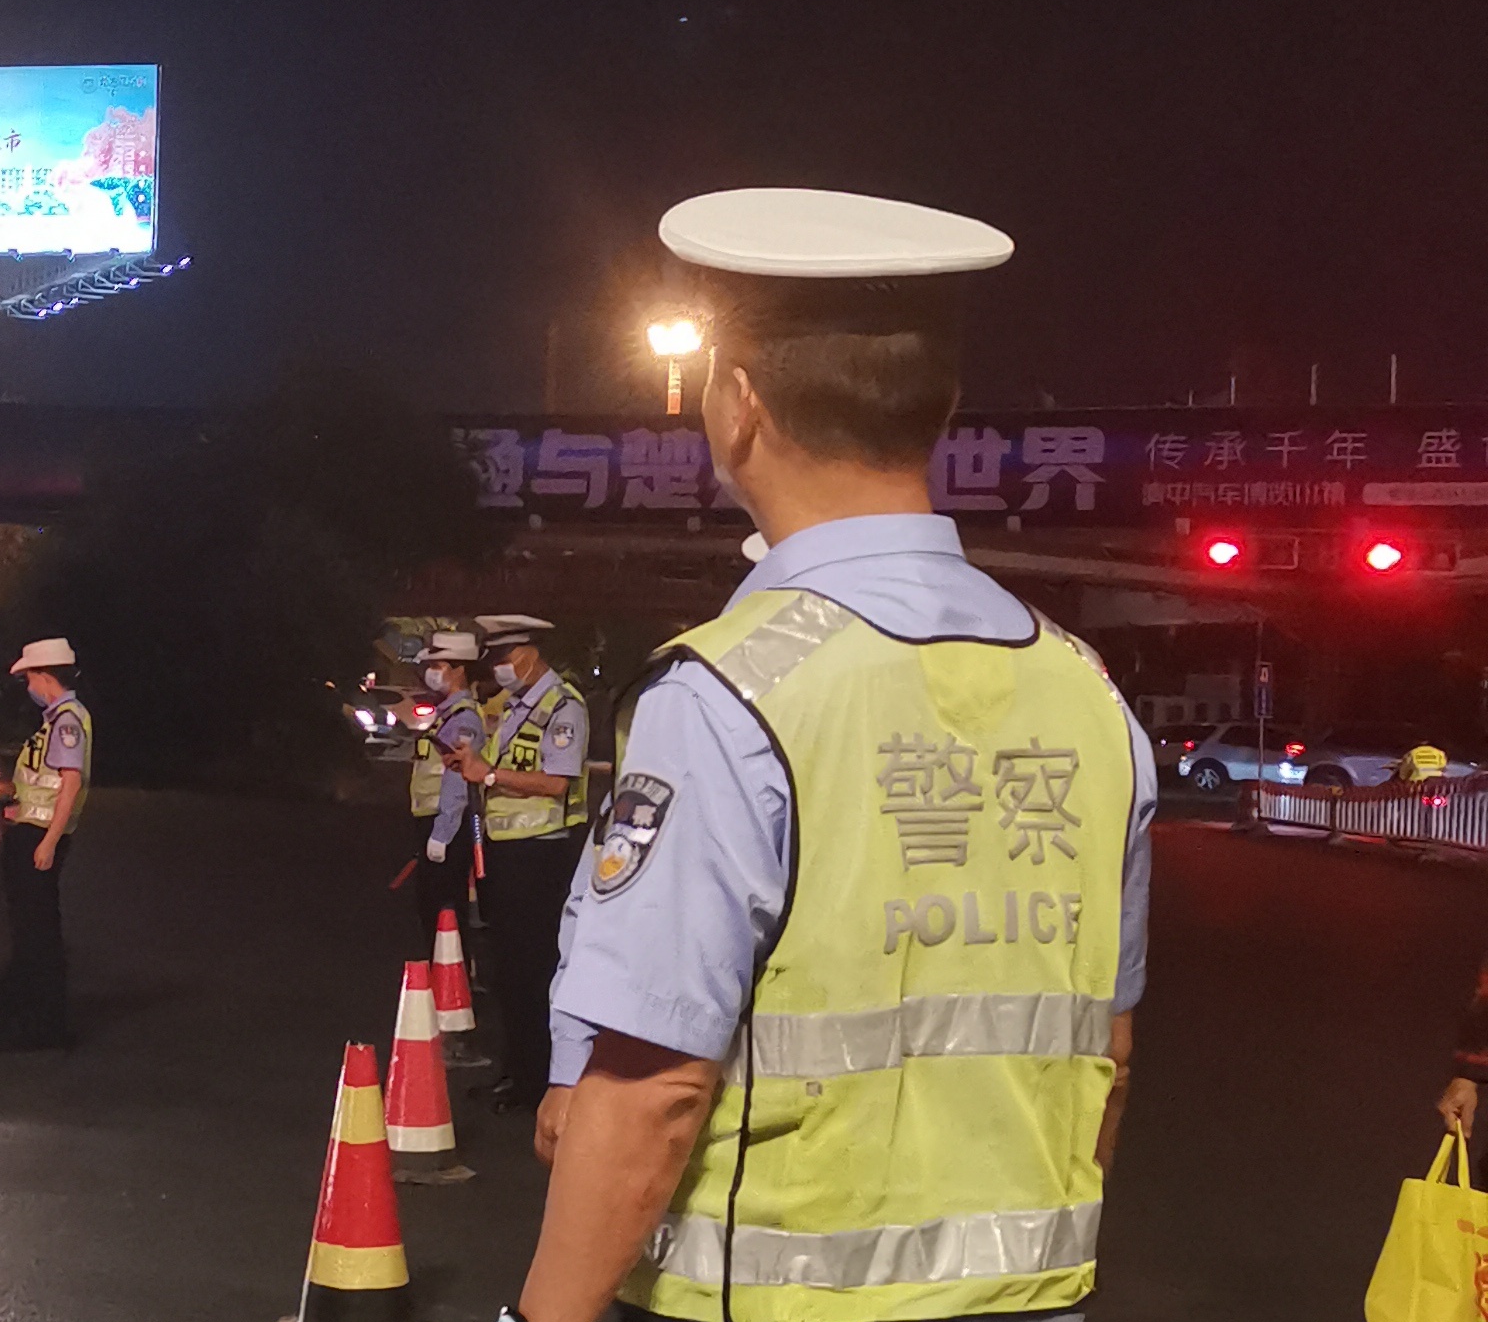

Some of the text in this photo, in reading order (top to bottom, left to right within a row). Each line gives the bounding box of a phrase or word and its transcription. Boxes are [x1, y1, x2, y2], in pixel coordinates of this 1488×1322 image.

[1145, 427, 1488, 471] 传承千年 盛
[875, 731, 1083, 872] 警察
[882, 890, 1083, 956] POLICE
